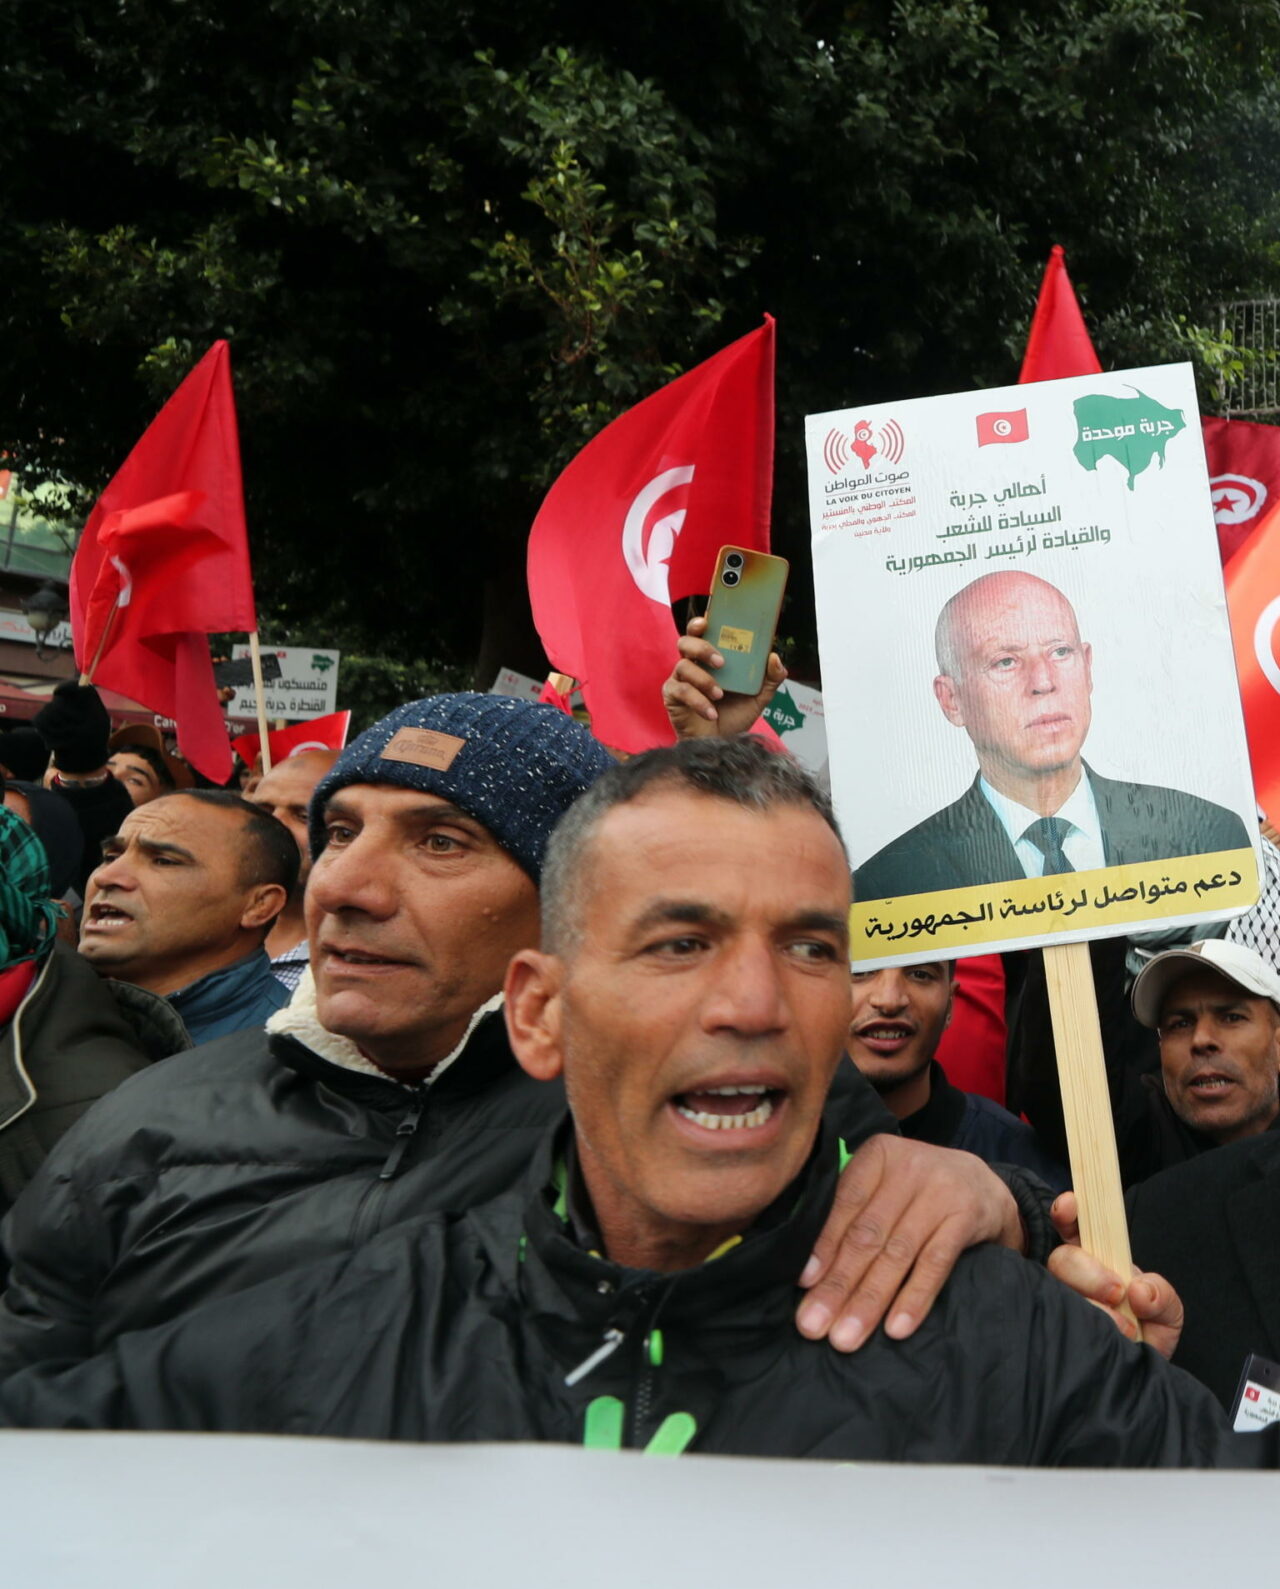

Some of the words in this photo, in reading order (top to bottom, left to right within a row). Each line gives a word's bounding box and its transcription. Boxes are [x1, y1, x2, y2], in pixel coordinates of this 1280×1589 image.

[1082, 424, 1135, 441] موحدة
[1139, 418, 1175, 437] جربة
[825, 473, 872, 493] المواطن
[875, 471, 910, 484] صوت
[993, 474, 1047, 507] أهالي
[839, 494, 859, 503] VOIX
[861, 492, 873, 500] DU
[875, 486, 911, 497] CITOYEN
[949, 490, 988, 510] جربة
[936, 514, 992, 543] للشعب
[998, 505, 1062, 531] السيادة
[984, 534, 1037, 560] لرئيس
[1042, 525, 1111, 551] والقيادة
[886, 543, 977, 576] الجمهورية
[773, 708, 796, 729] جربة
[1093, 877, 1188, 909] متواصل
[1193, 870, 1242, 898] دعم
[999, 889, 1088, 920] لرئاسة
